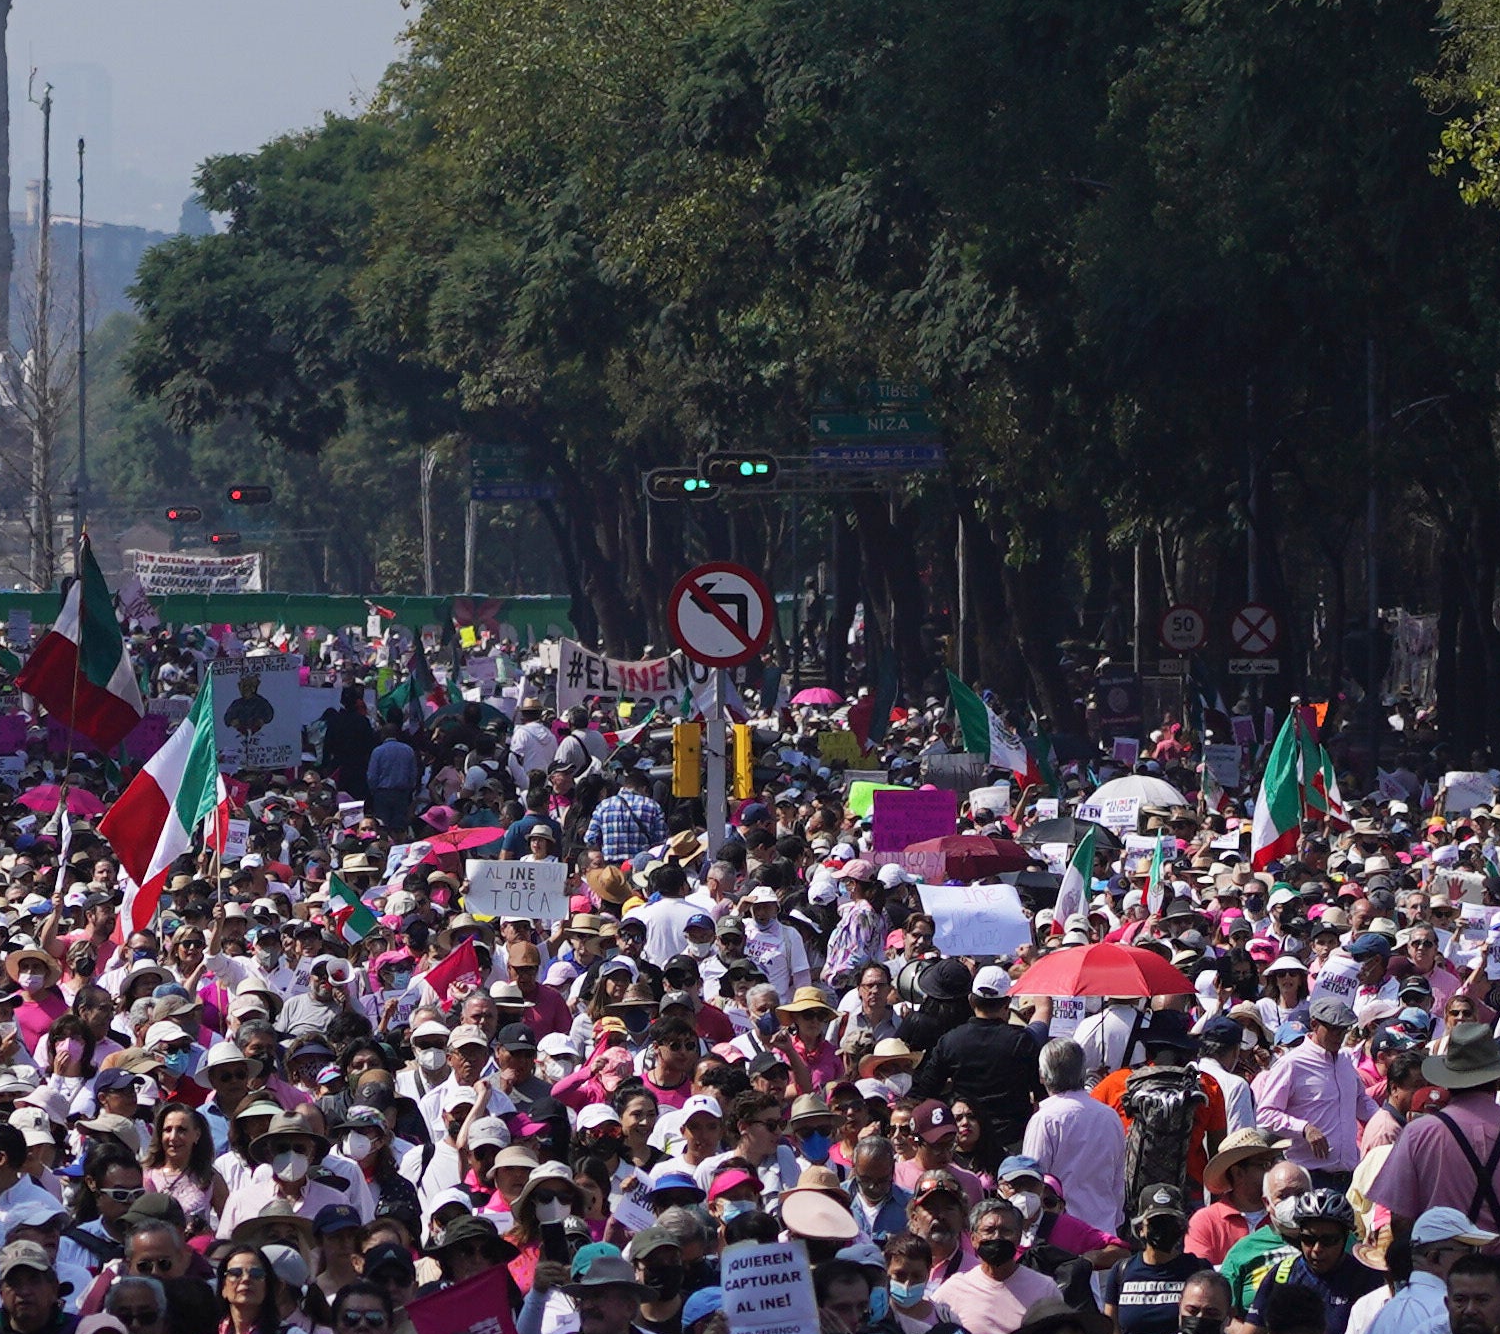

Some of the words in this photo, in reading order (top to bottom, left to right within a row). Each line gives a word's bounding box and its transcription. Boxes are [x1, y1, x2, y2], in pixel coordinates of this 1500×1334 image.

[1172, 617, 1195, 633] 50
[566, 651, 709, 691] #ELINENO
[485, 867, 502, 881] AL
[510, 867, 536, 881] INE
[505, 881, 517, 890] no
[523, 881, 536, 891] se
[489, 889, 551, 913] TOCA
[1052, 999, 1084, 1010] ELINENO
[728, 1251, 793, 1275] ¡QUIEREN
[724, 1270, 802, 1294] CAPTURAR
[736, 1300, 756, 1315] AL
[760, 1293, 791, 1312] INE!
